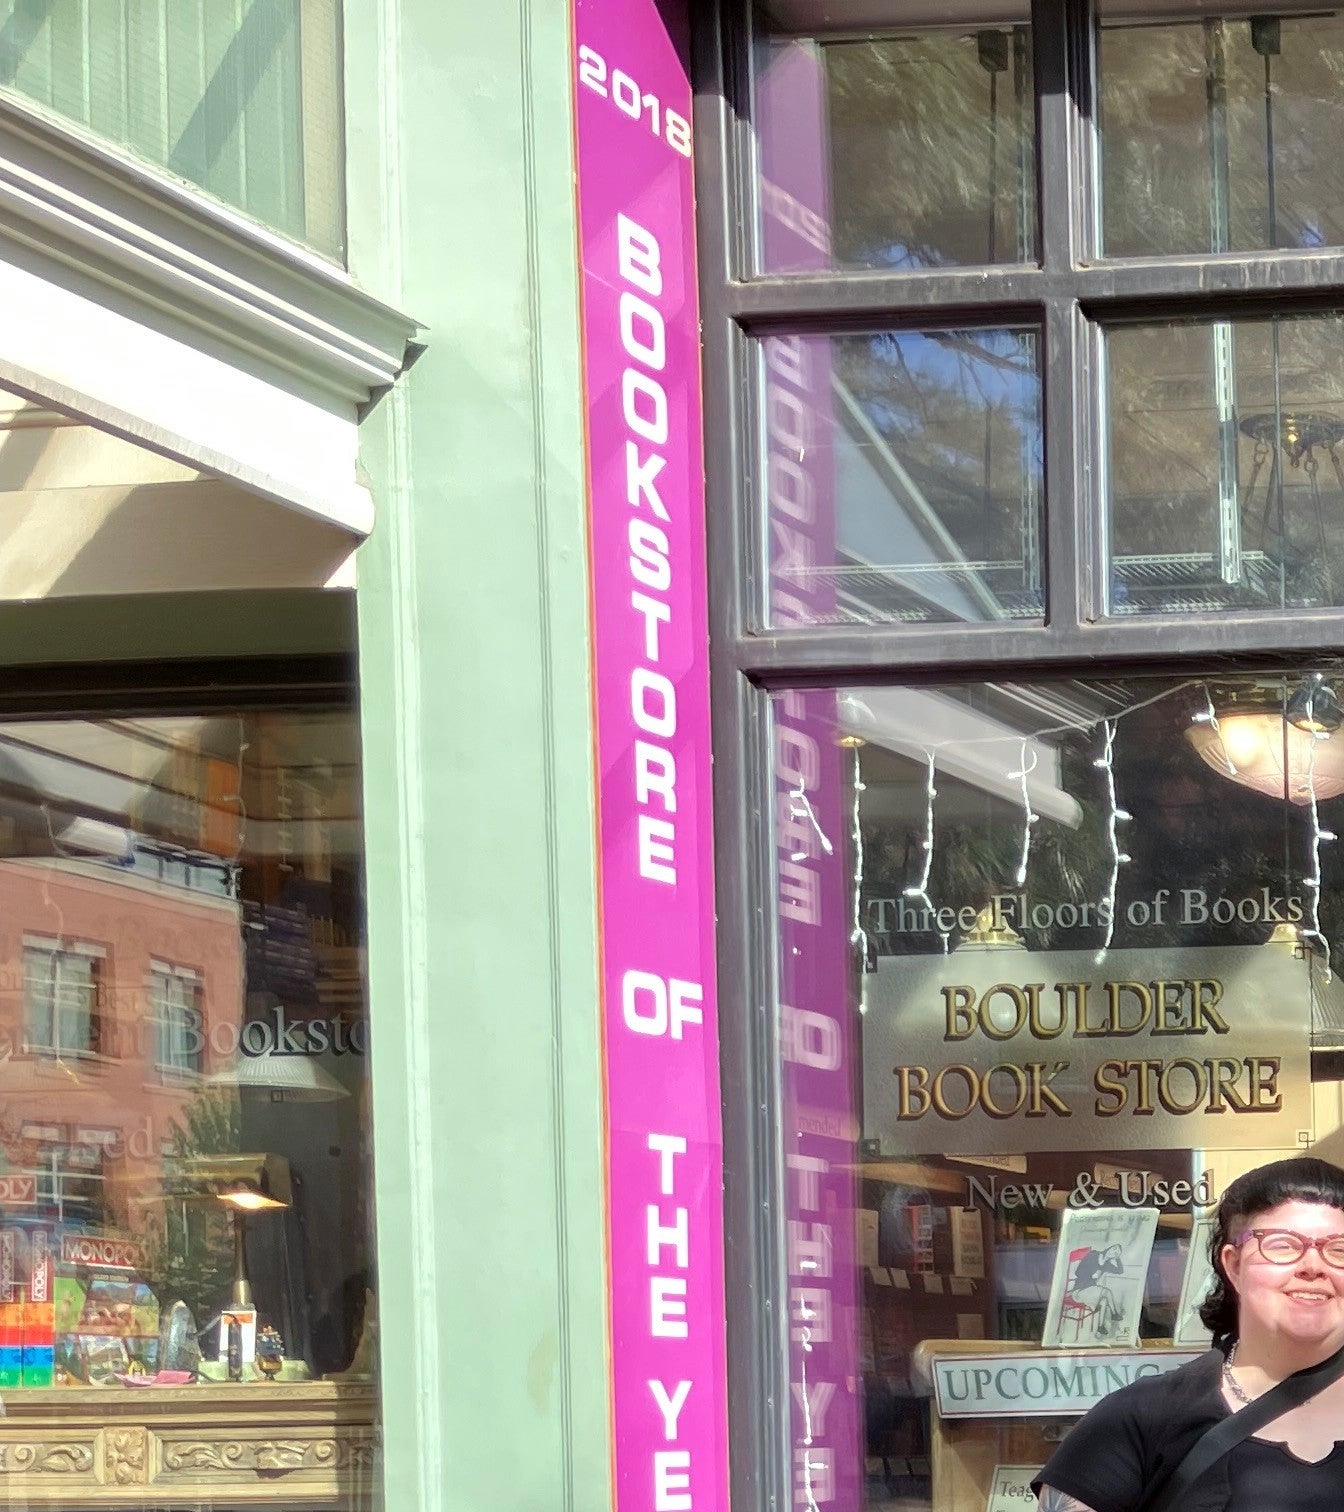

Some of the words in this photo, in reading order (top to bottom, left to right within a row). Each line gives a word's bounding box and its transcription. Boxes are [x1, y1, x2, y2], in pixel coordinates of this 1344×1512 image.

[579, 44, 692, 158] 2018
[616, 213, 677, 885] BOOKSTORE
[868, 898, 978, 934] Three
[990, 893, 1115, 933] Floors
[1127, 889, 1166, 926] of
[1180, 888, 1304, 925] Books
[181, 1005, 370, 1058] Booksto
[622, 970, 703, 1040] OF
[941, 978, 1231, 1043] BOULDER
[894, 1060, 1073, 1122] BOOK
[1094, 1055, 1284, 1118] STORE
[964, 1174, 1055, 1212] New
[1069, 1171, 1105, 1209] &
[1116, 1168, 1219, 1208] Used
[646, 1133, 690, 1339] THE
[1000, 1481, 1035, 1503] Teag
